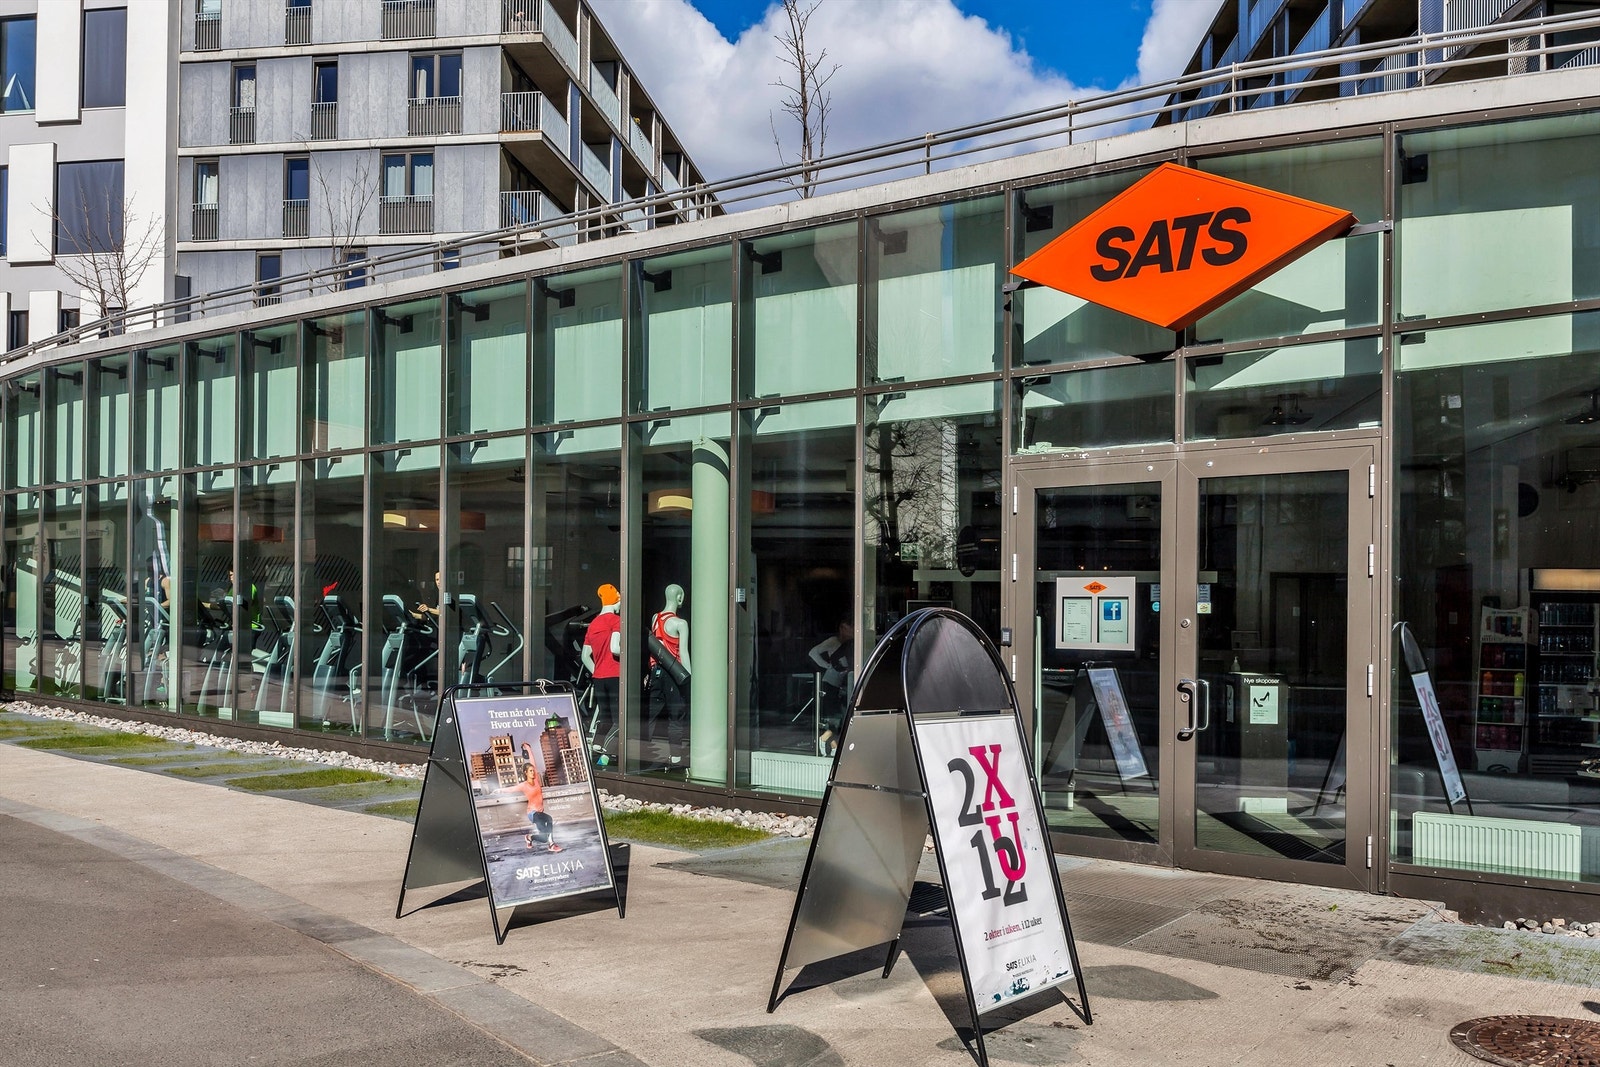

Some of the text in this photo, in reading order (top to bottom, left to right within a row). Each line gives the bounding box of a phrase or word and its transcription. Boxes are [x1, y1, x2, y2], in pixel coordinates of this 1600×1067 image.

[1090, 207, 1251, 282] SATS
[1243, 677, 1254, 685] Nye
[488, 707, 549, 719] Tren når du vil.
[490, 718, 537, 729] Hvor du vil.
[515, 866, 541, 880] SATS
[542, 859, 584, 876] ELIXIA
[983, 931, 989, 941] 2
[1024, 919, 1031, 929] 12
[1030, 917, 1043, 927] uker
[1005, 960, 1018, 971] SATS
